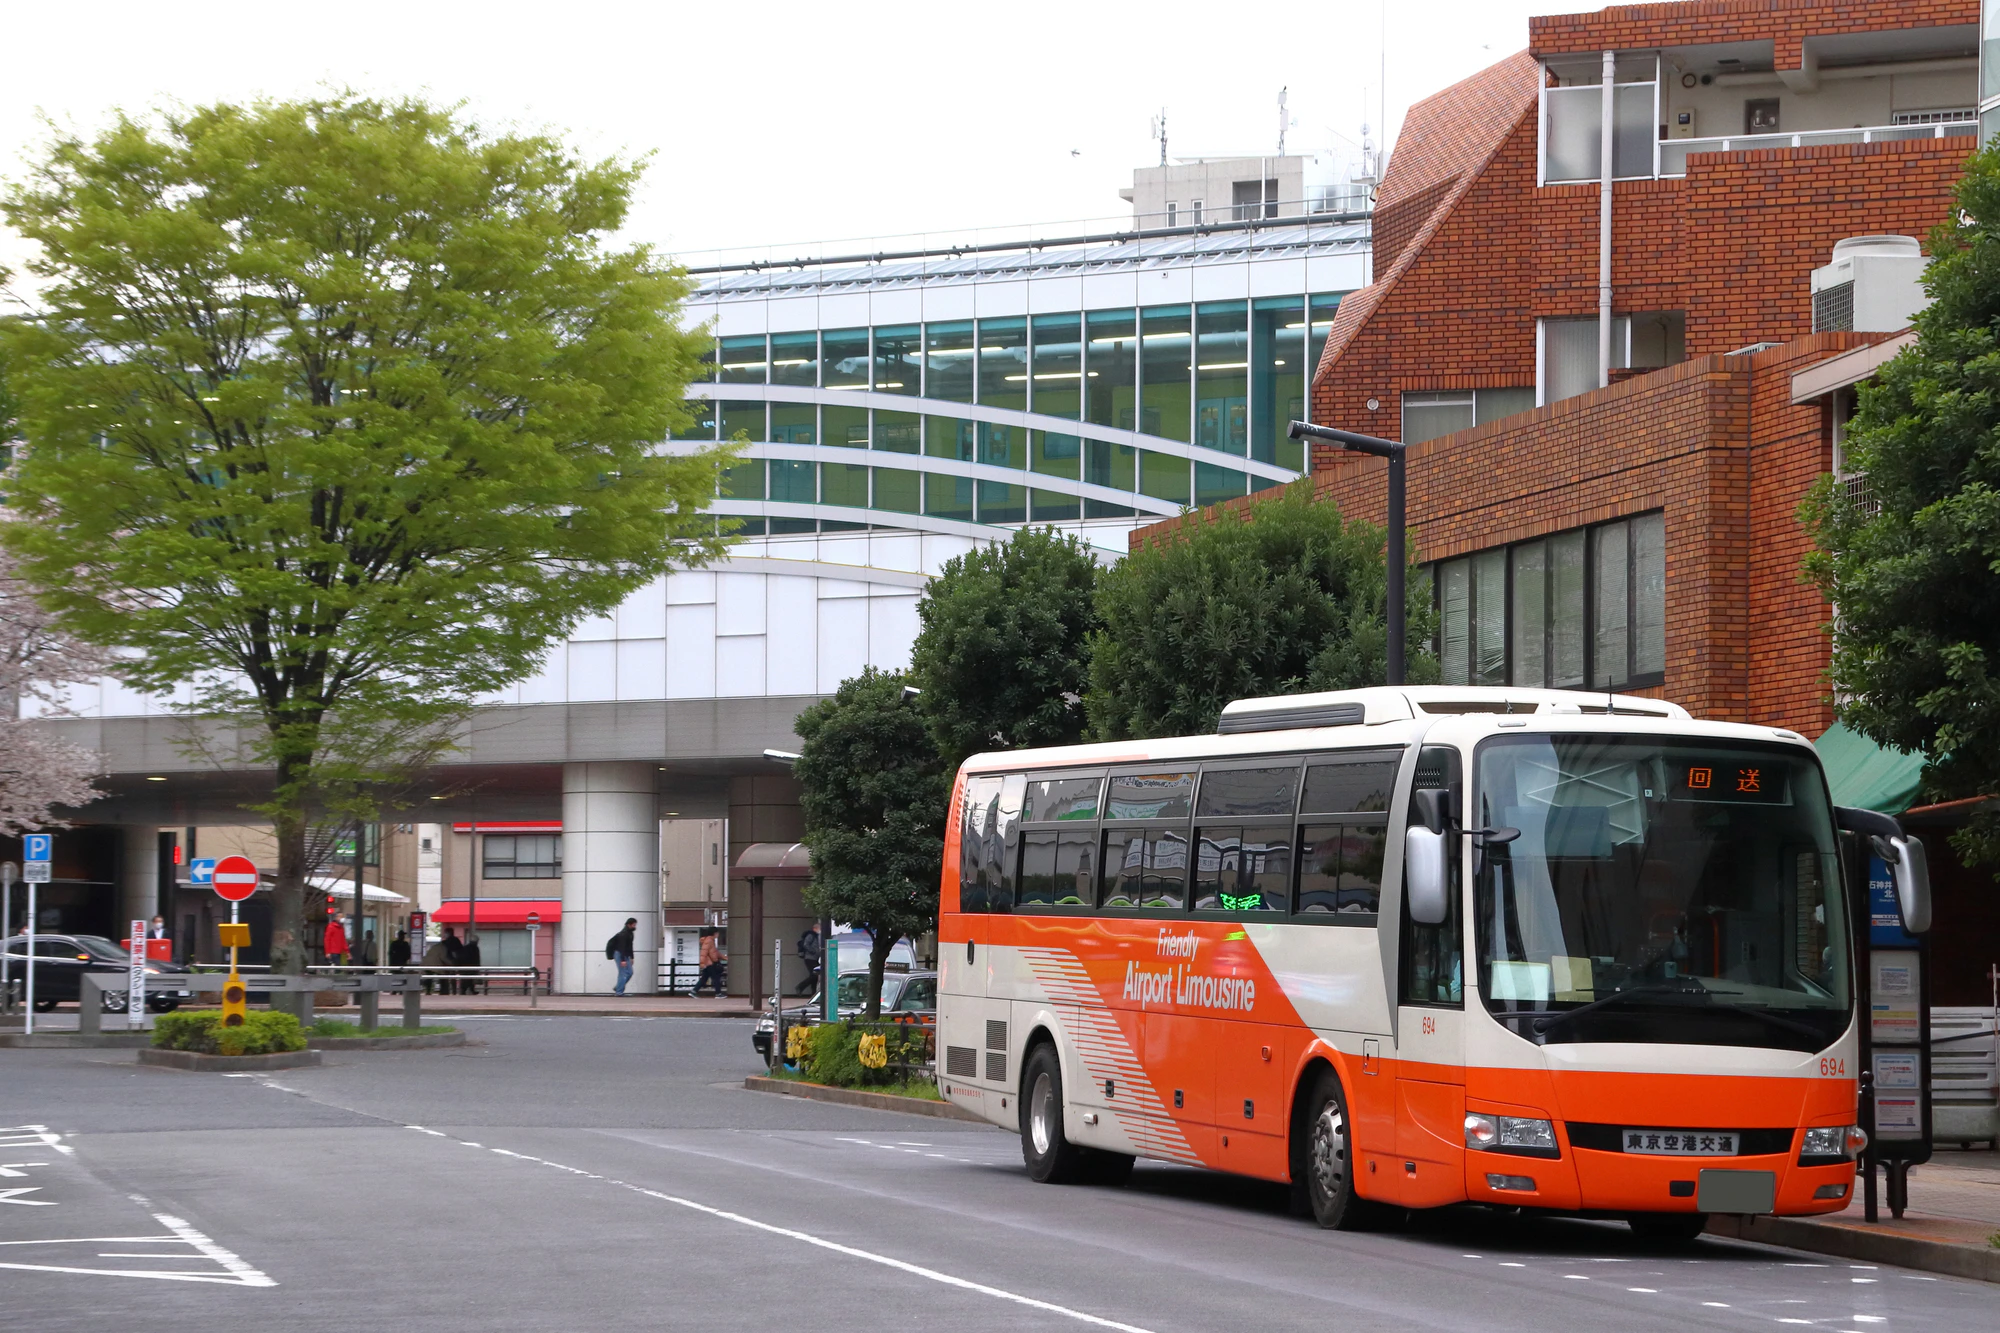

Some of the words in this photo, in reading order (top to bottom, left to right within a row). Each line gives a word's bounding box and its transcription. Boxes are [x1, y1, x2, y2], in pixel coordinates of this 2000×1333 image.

[1688, 767, 1760, 792] 回送
[30, 837, 46, 859] P
[1156, 928, 1200, 961] Friendly
[1123, 960, 1172, 1010] Airport
[1176, 963, 1255, 1012] Limousine
[1422, 1016, 1435, 1035] 694
[1820, 1057, 1845, 1077] 694
[1627, 1133, 1733, 1152] 東京空港交通
